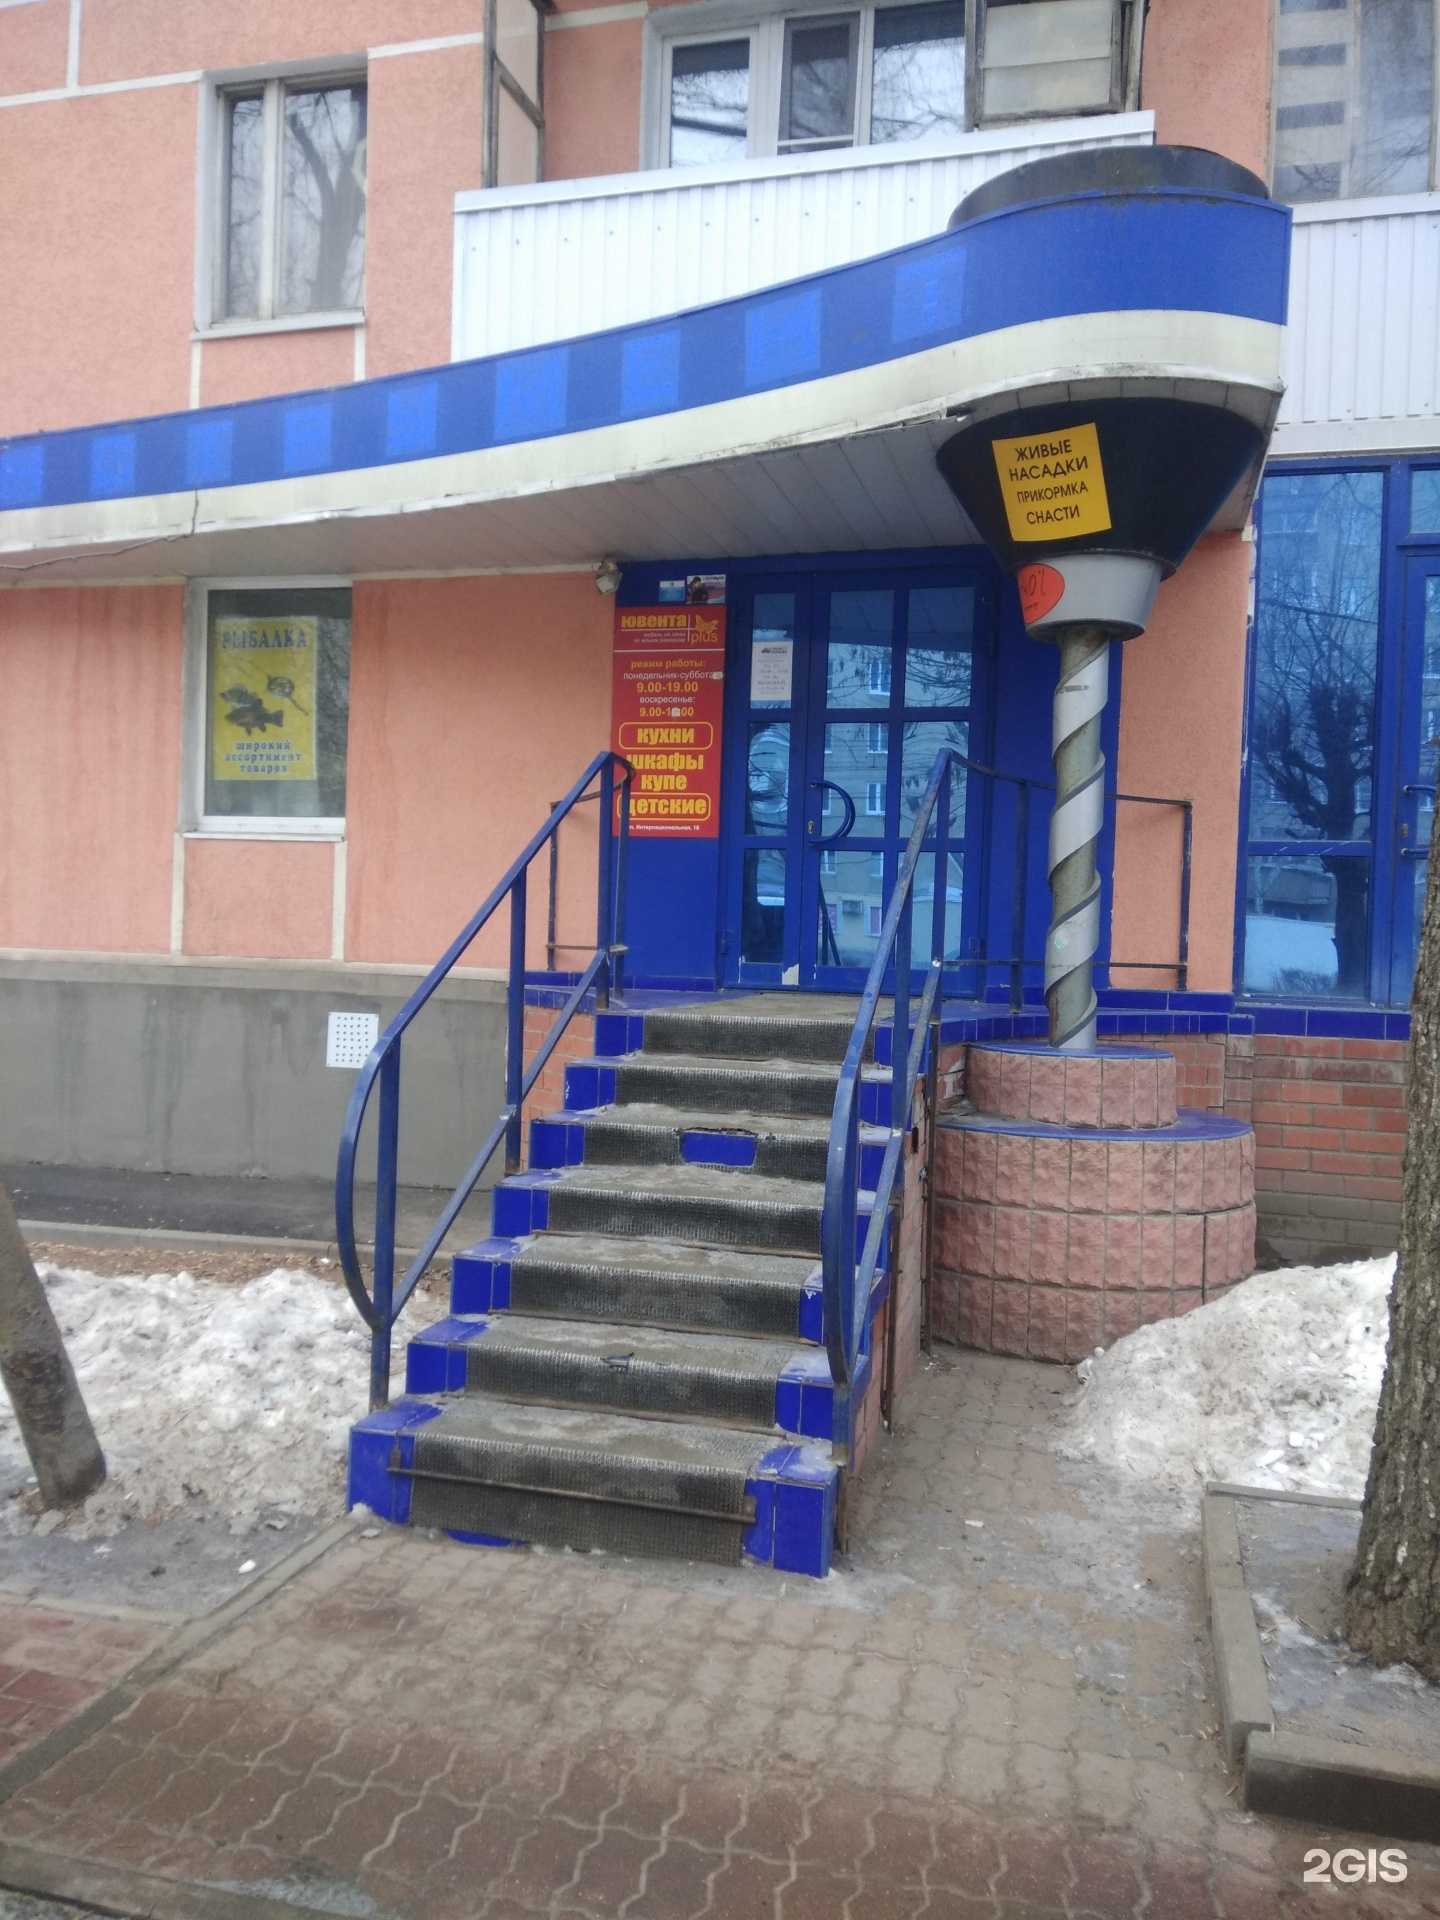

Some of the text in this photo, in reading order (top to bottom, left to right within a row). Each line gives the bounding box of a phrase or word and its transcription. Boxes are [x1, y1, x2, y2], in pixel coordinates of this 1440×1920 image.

[1016, 440, 1072, 461] ЖИВЫЕ
[1009, 456, 1089, 482] НАСАДКИ
[1017, 481, 1089, 504] ПРИКОРМКА
[1026, 505, 1080, 525] СНАСТИ
[222, 629, 307, 649] РЫБАЛКА
[691, 630, 718, 645] plus
[636, 681, 698, 693] 9.00-19.00
[637, 728, 694, 744] кухни
[641, 774, 687, 791] купе
